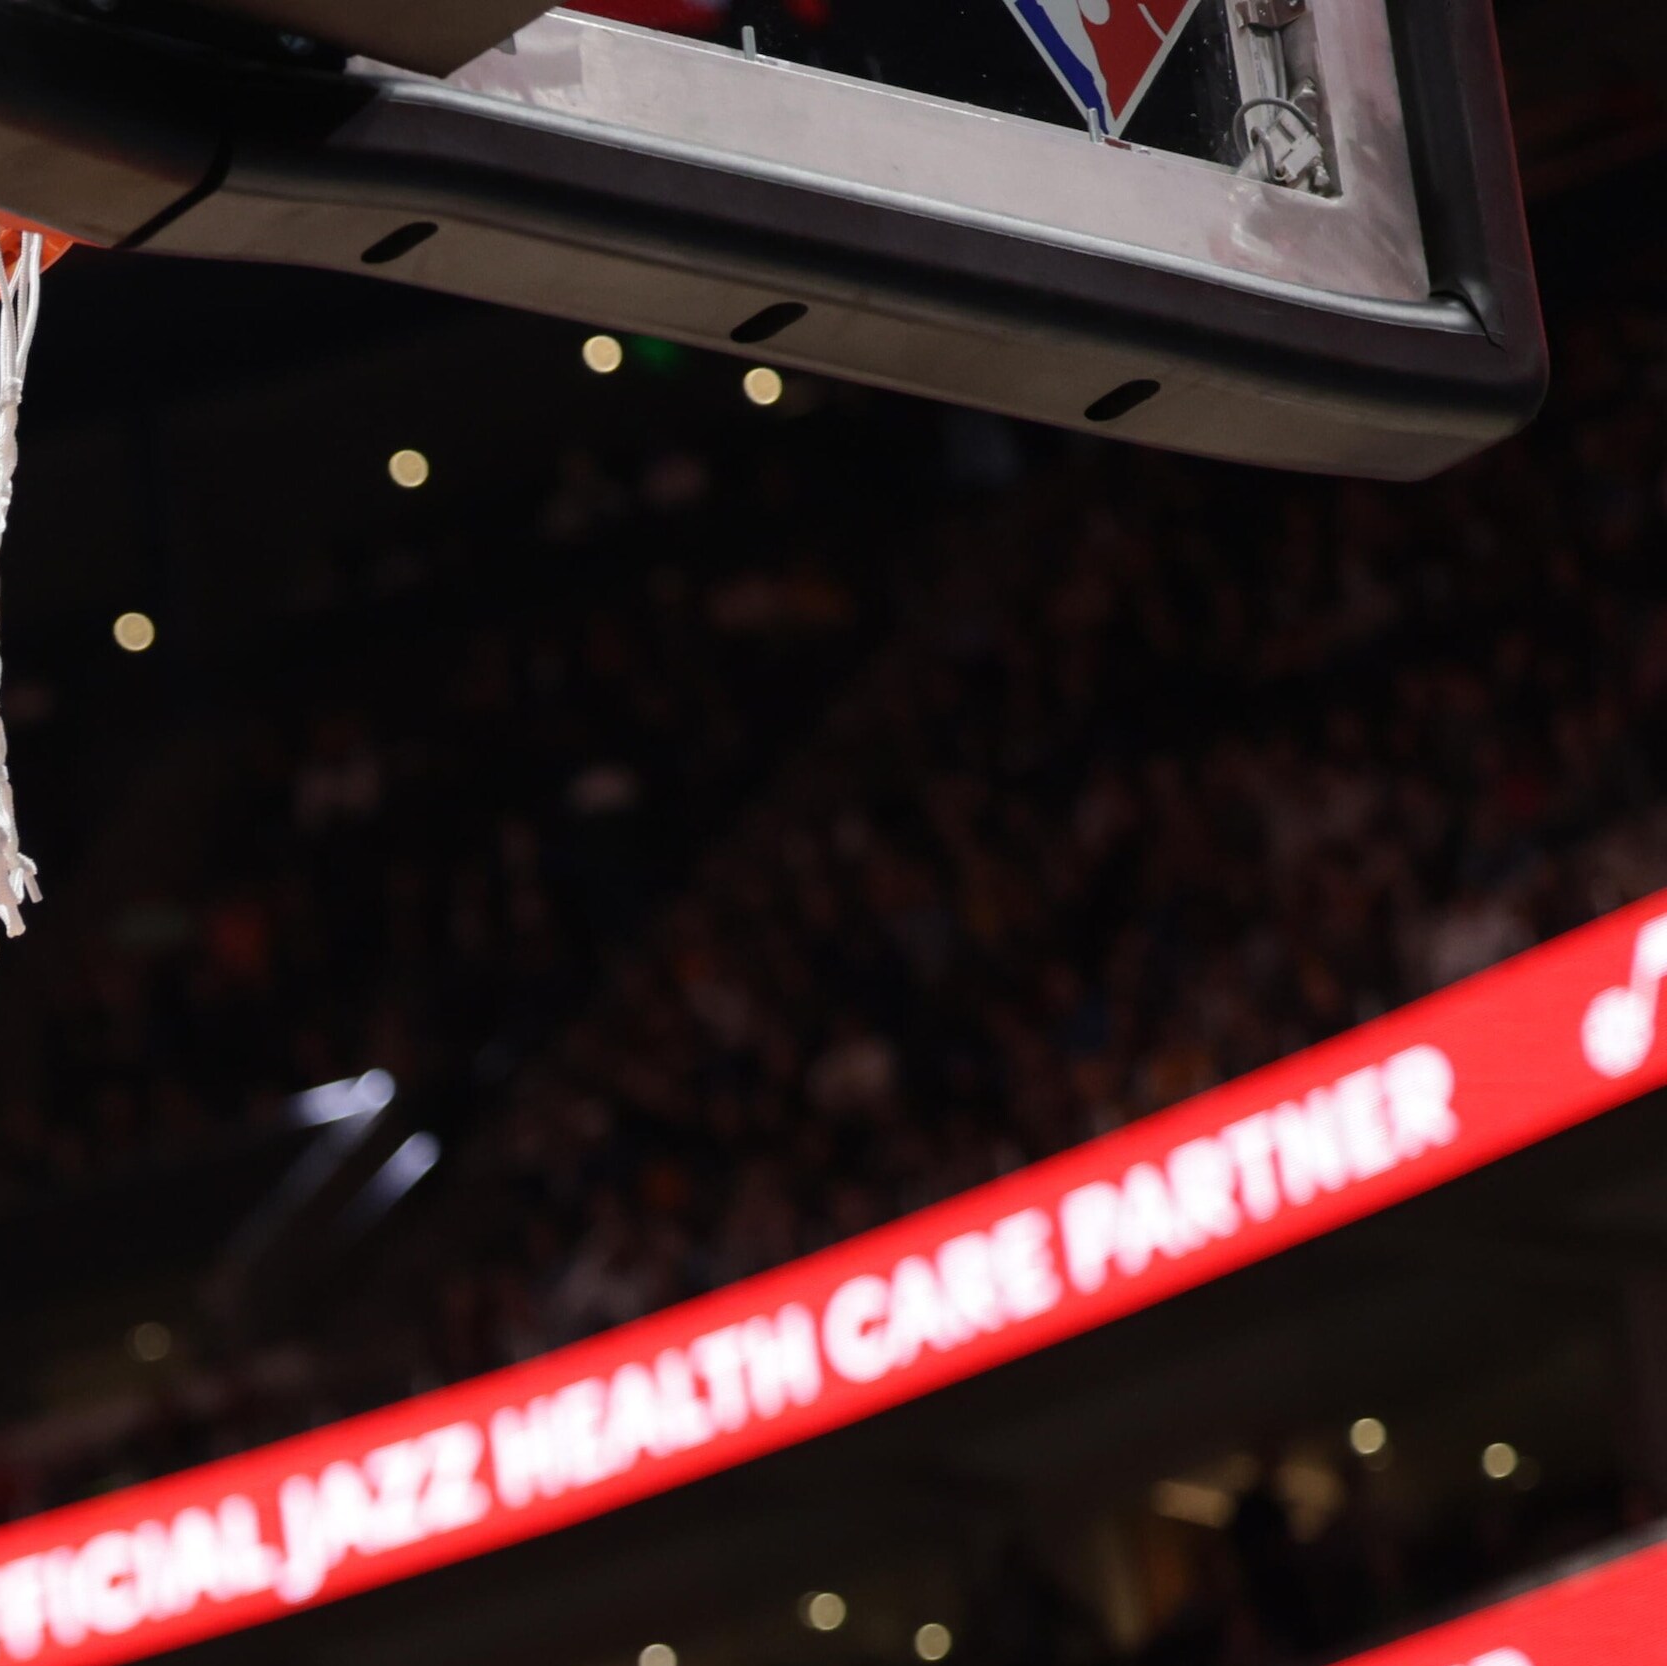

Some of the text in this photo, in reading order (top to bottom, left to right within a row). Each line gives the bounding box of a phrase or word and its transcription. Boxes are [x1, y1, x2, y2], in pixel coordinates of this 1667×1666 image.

[273, 1422, 491, 1602] JAZZ
[492, 1305, 821, 1507] HEALTH
[823, 1210, 1061, 1384] CARE
[1060, 1045, 1457, 1292] PARTNER
